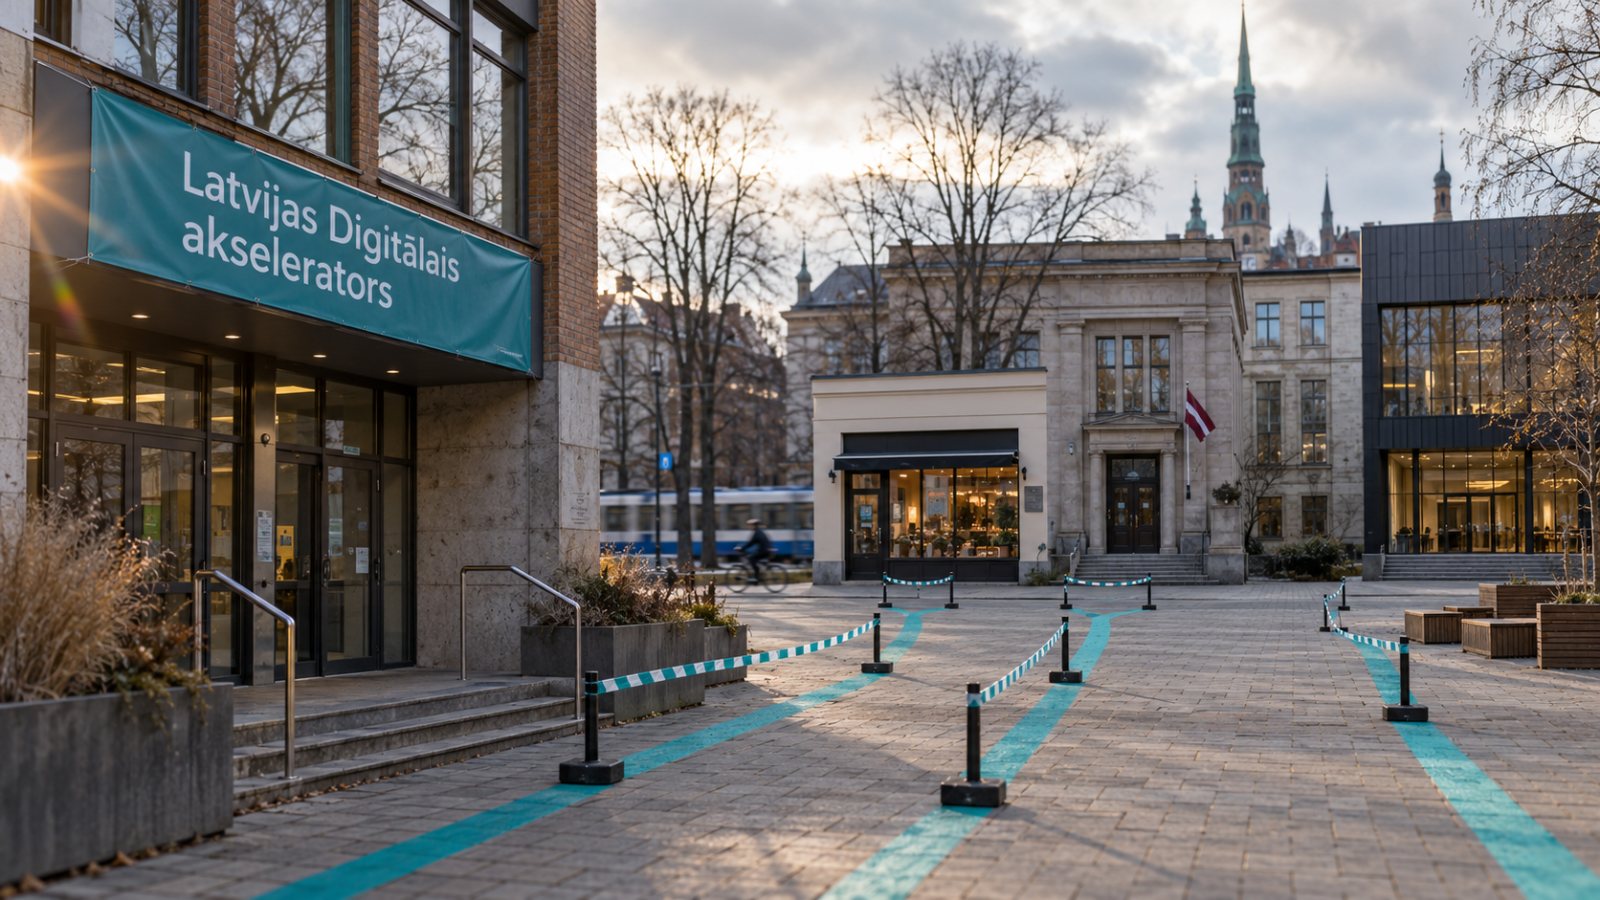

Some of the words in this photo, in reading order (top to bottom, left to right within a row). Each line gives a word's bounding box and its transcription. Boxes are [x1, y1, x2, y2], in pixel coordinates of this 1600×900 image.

[182, 215, 393, 308] akselerators
[184, 151, 318, 234] Latvijas
[329, 204, 460, 282] Digitālais
